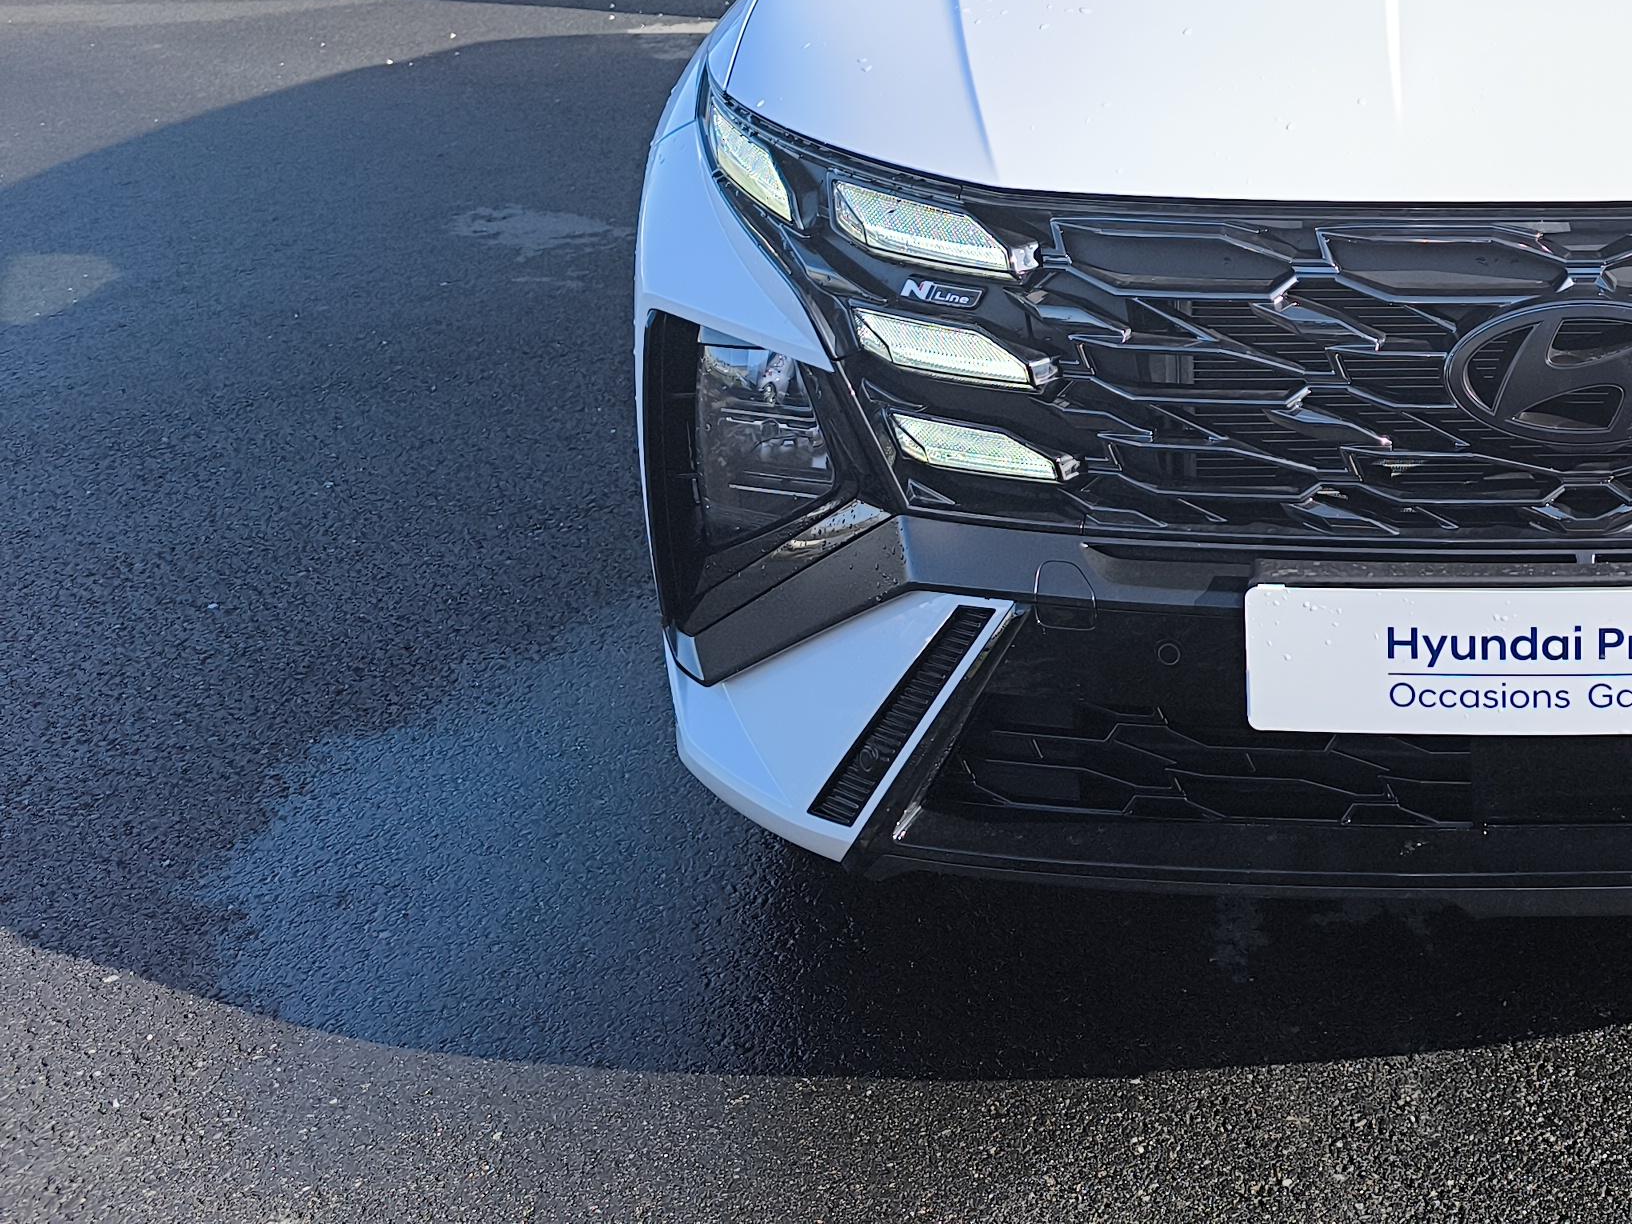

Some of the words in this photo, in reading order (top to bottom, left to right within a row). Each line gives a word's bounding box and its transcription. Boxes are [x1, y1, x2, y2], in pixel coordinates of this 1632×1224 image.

[935, 291, 970, 304] Line
[1386, 624, 1582, 668] Hyundai
[1389, 681, 1571, 709] Occasions
